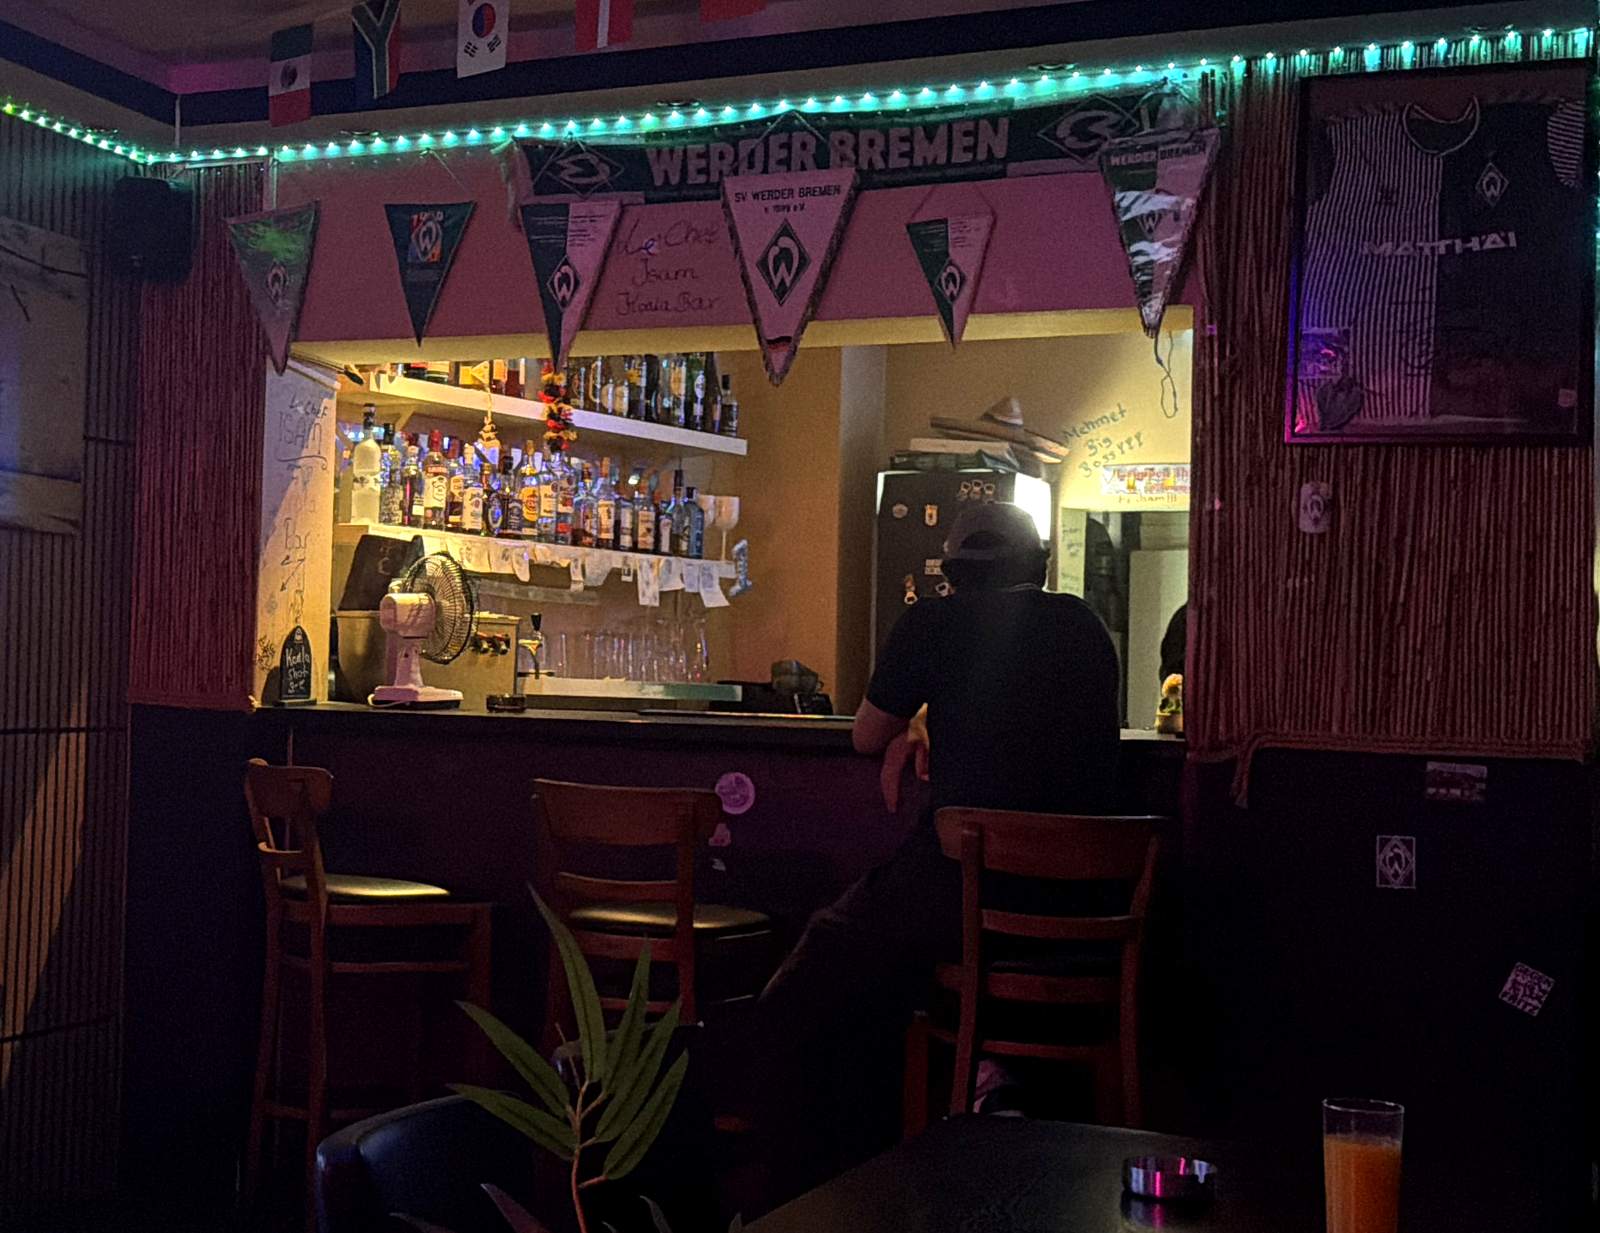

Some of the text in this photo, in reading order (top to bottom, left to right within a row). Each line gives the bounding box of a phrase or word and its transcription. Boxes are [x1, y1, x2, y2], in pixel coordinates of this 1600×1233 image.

[647, 116, 1009, 187] WERDER BREMEN
[734, 184, 841, 203] SV WERDER BREMEN
